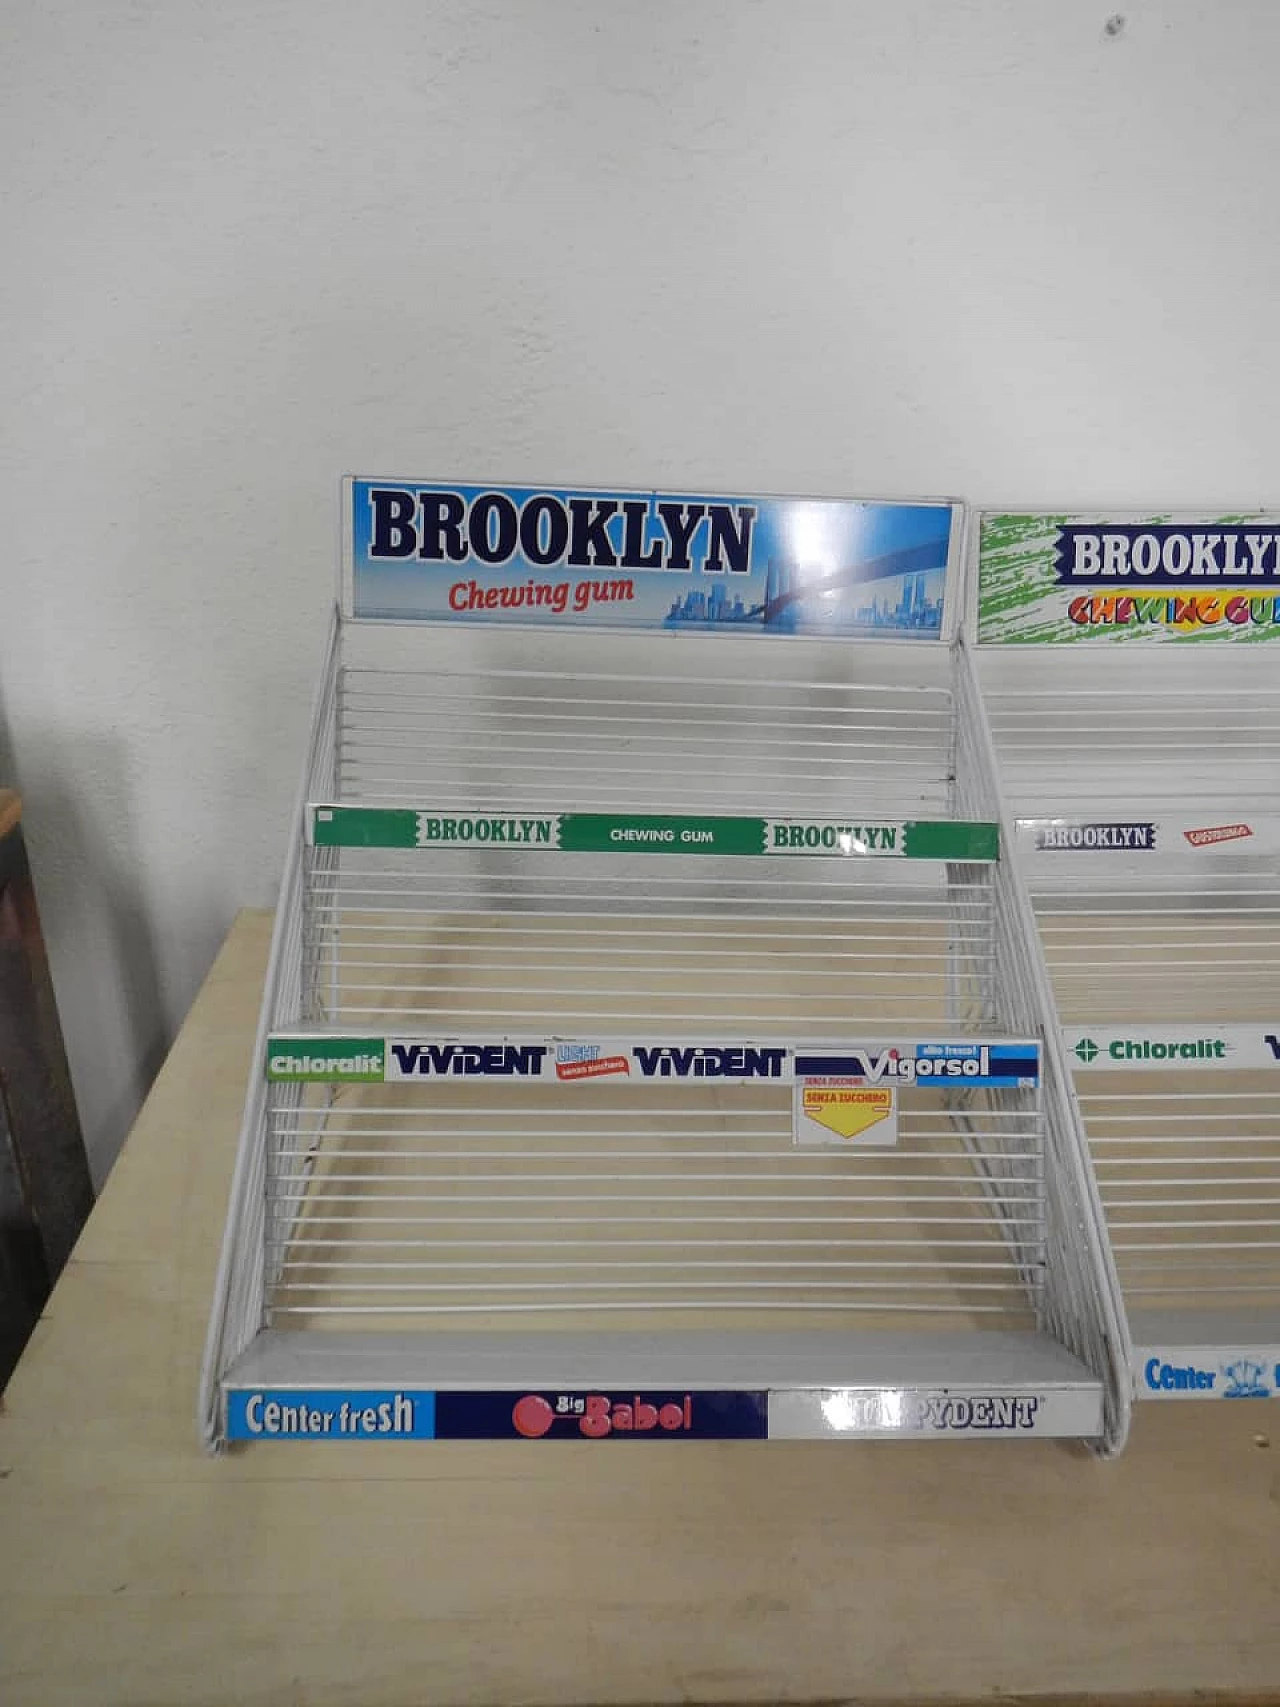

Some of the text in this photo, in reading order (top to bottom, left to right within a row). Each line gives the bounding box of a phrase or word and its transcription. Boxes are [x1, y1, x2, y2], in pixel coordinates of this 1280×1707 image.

[368, 488, 757, 574] BROOKLYN
[449, 578, 634, 614] Chewing gum
[1068, 596, 1222, 625] CHEWING
[426, 818, 551, 843] BROOKLYN
[610, 829, 675, 843] CHEWING
[680, 830, 714, 844] GUM
[1044, 827, 1149, 848] BROOKLYN
[270, 1054, 383, 1074] Chloralit
[1109, 1038, 1226, 1060] Chloralit
[858, 1045, 990, 1084] Vigorsol
[807, 1092, 887, 1104] SENZA ZUCCHERO
[1145, 1358, 1217, 1389] Center
[245, 1394, 415, 1433] Center fresh
[556, 1394, 692, 1437] Big Babol
